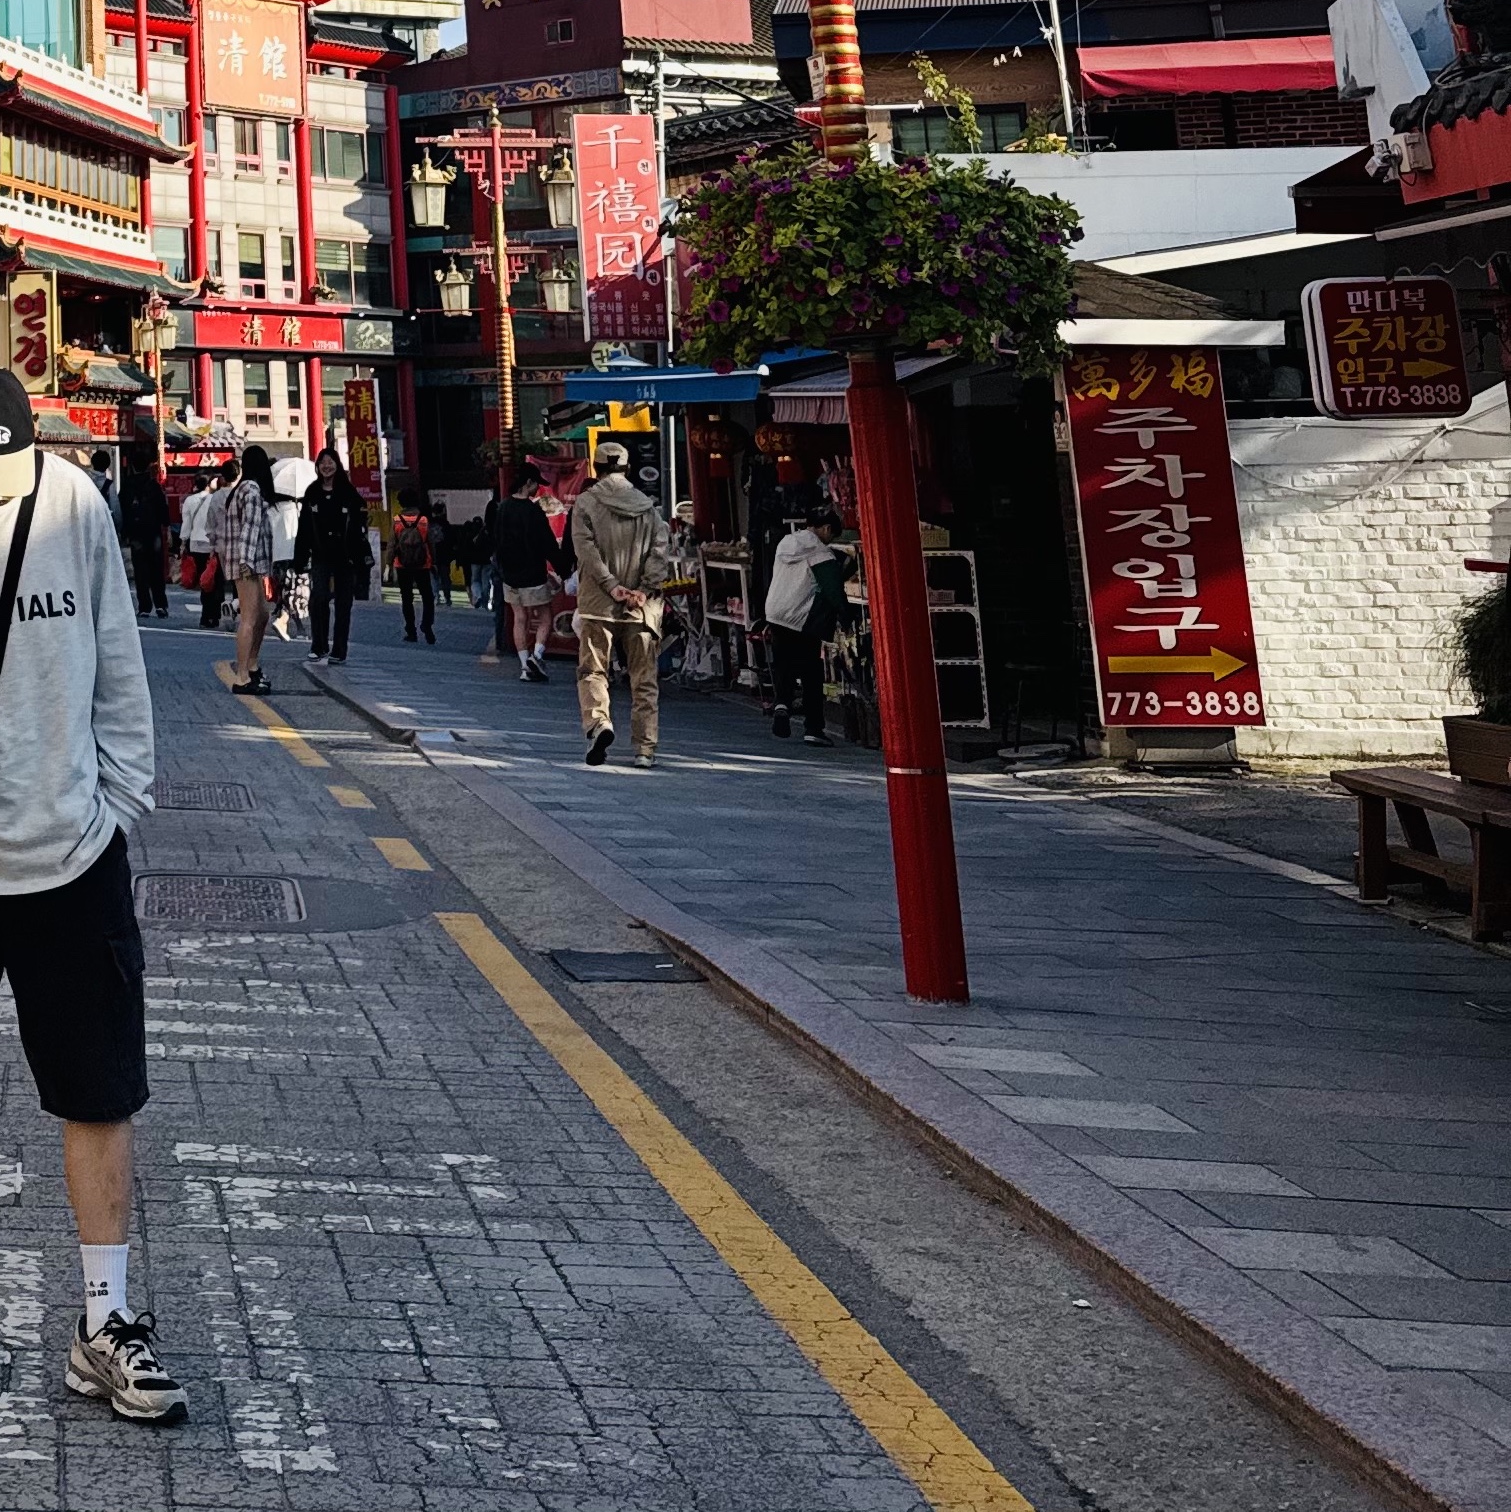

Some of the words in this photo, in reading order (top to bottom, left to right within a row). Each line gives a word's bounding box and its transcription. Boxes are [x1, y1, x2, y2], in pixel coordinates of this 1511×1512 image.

[582, 124, 648, 281] 千禧园
[1346, 288, 1427, 313] 만다복
[13, 288, 48, 377] 연경
[1333, 313, 1450, 354] 주차장
[1070, 348, 1216, 400] 萬多福
[1336, 357, 1397, 385] 입구
[1340, 384, 1462, 408] T.773-3838
[348, 386, 378, 468] 清館
[1093, 406, 1220, 650] 주차장입구
[1107, 690, 1262, 717] 773-3838
